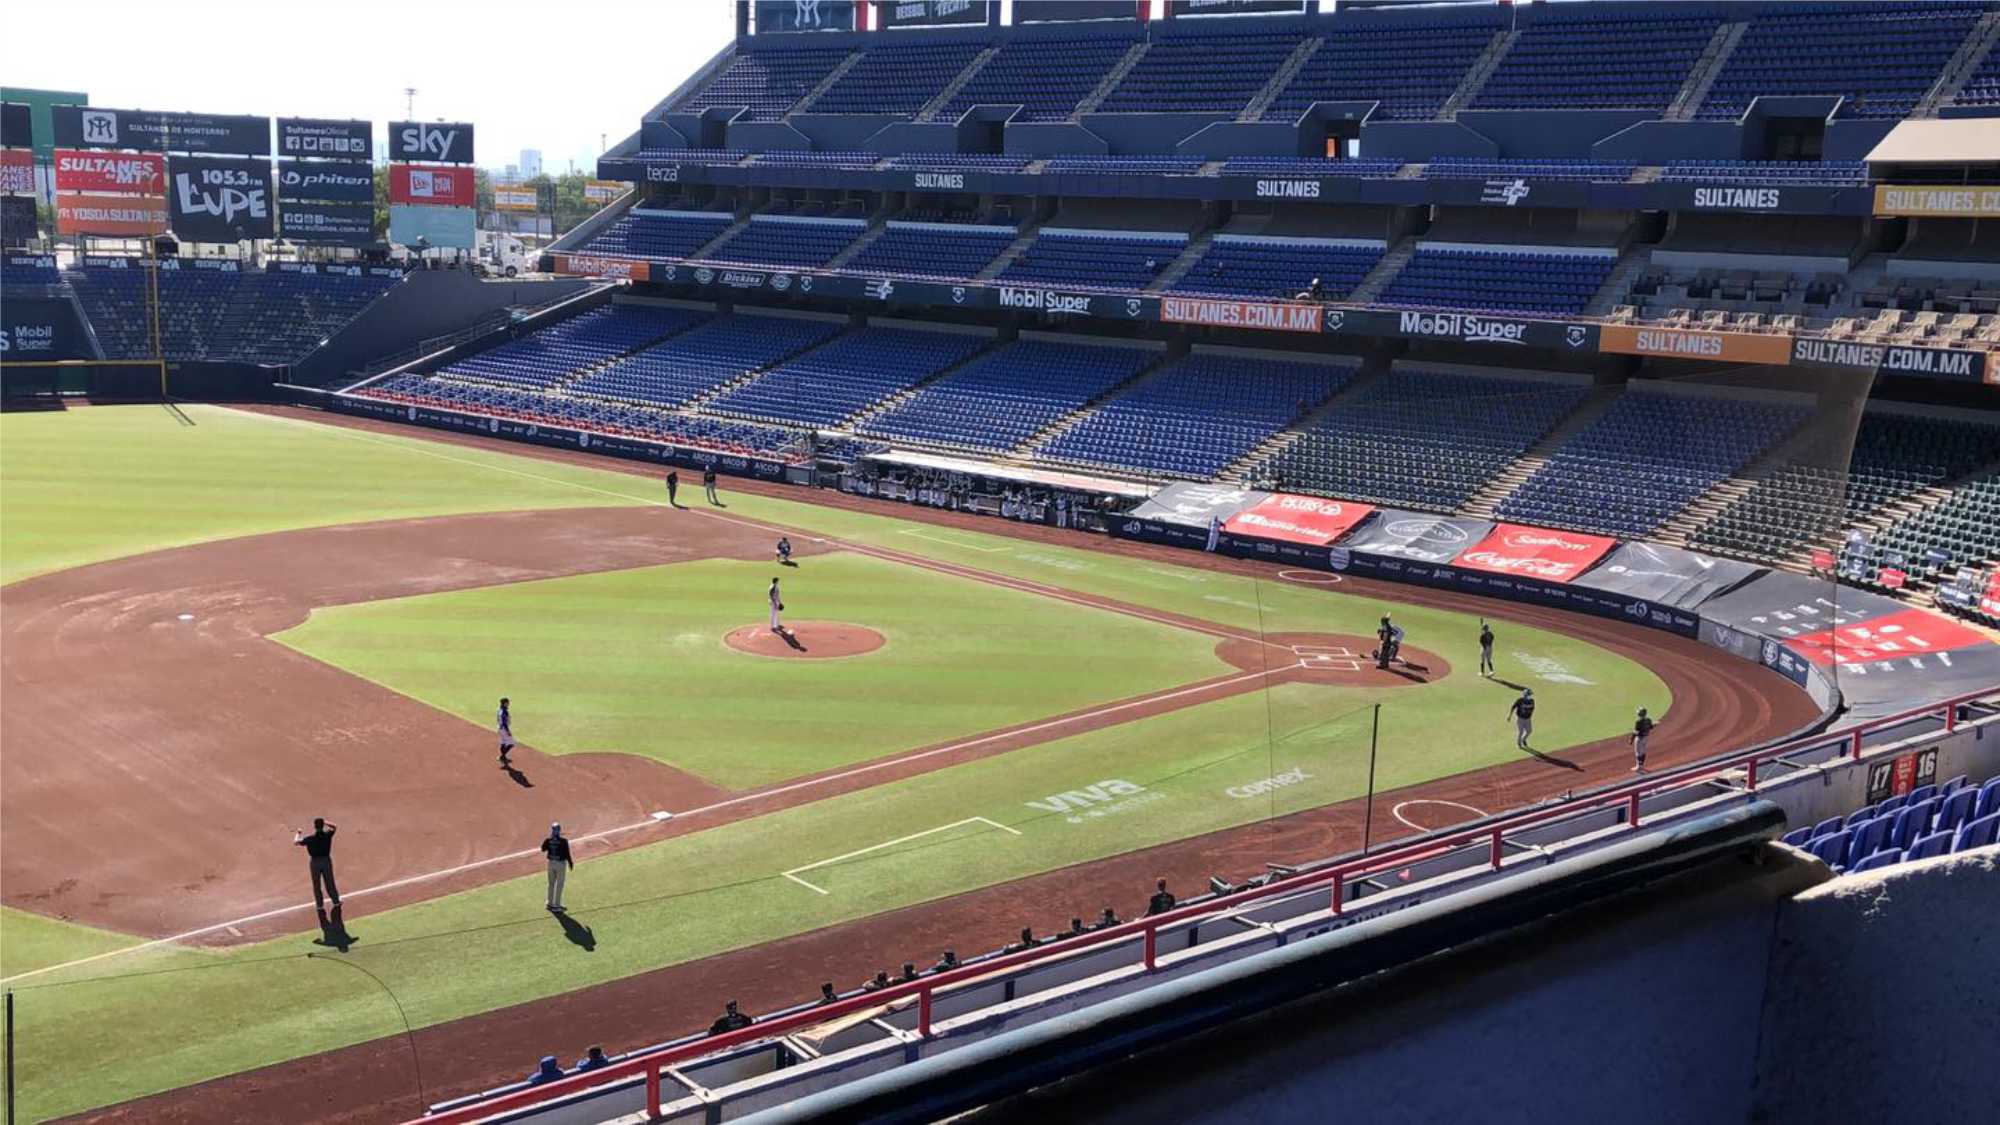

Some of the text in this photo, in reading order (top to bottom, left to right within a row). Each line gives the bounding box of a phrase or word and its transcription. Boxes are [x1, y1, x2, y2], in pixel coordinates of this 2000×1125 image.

[59, 157, 153, 173] SULTANES
[646, 165, 680, 182] terza
[202, 170, 248, 185] 105.3
[303, 171, 369, 187] phiten
[915, 174, 964, 189] SULTANES
[1256, 180, 1320, 197] SULTANES
[1694, 188, 1779, 208] SULTANES
[1164, 301, 1318, 330] SULTANES.COM.MX
[15, 326, 53, 337] Mobil
[16, 338, 53, 350] Super
[1637, 330, 1722, 356] SULTANES
[1795, 339, 1974, 376] SULTANES.COM.MX
[1918, 751, 1936, 778] 16
[1871, 763, 1892, 791] 17
